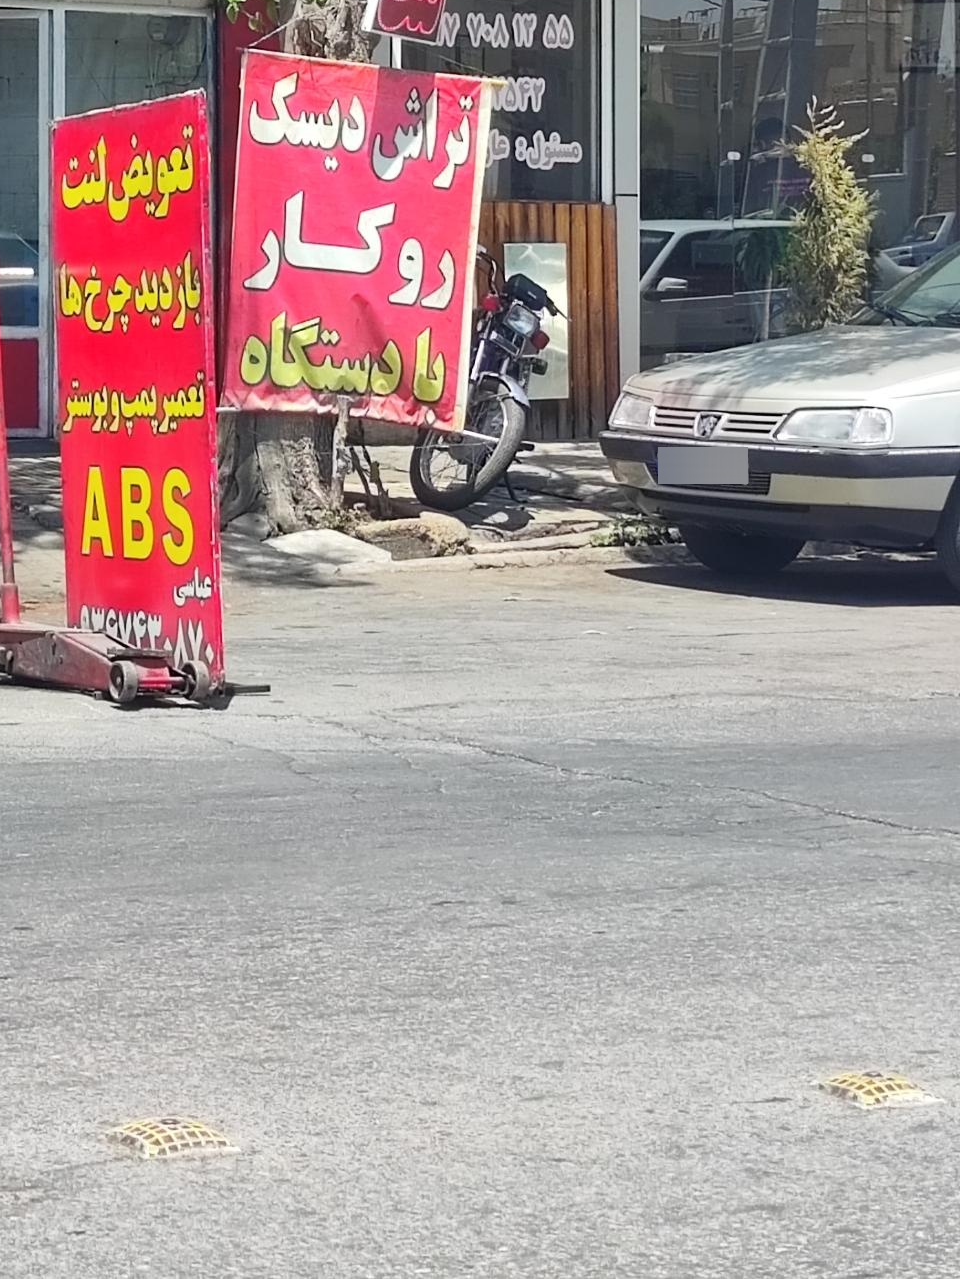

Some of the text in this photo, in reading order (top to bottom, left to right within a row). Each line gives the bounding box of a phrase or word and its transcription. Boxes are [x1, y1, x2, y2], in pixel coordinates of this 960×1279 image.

[248, 72, 471, 189] تراش دیسک
[61, 125, 195, 222] تعویض لنت
[84, 265, 132, 334] چرخ
[134, 251, 201, 330] بازدید
[240, 310, 446, 424] با دستگاه
[62, 378, 108, 434] بوستر
[120, 383, 158, 438] پمپ
[158, 371, 206, 434] تعمیر
[81, 465, 195, 566] ABS
[172, 567, 213, 607] عباسی
[72, 603, 215, 667] ۹۳۶۷۴۳۰۸۷۰
